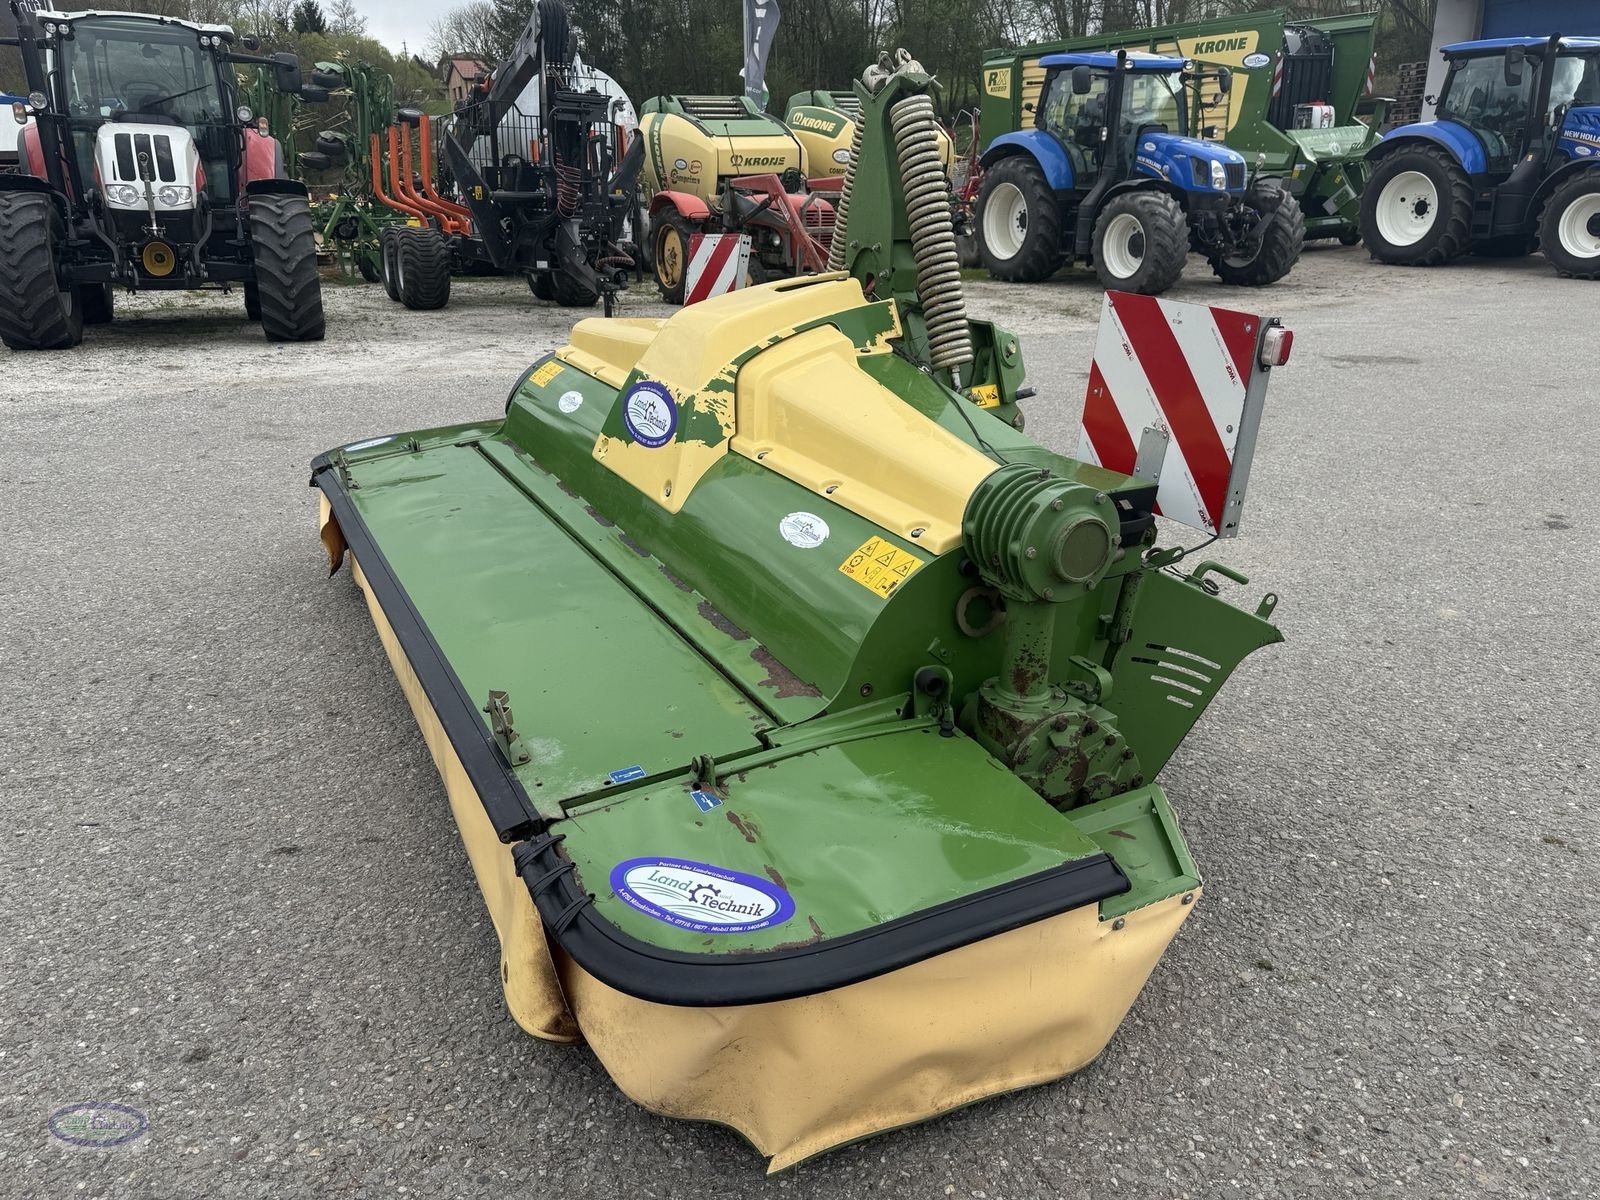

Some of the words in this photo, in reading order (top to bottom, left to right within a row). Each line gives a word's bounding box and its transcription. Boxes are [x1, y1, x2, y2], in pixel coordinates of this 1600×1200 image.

[1193, 37, 1248, 55] KRONE
[801, 116, 836, 132] KRONE
[1563, 130, 1580, 139] NEW
[744, 156, 786, 167] KRONE
[648, 869, 693, 892] Land
[700, 894, 765, 917] Technik
